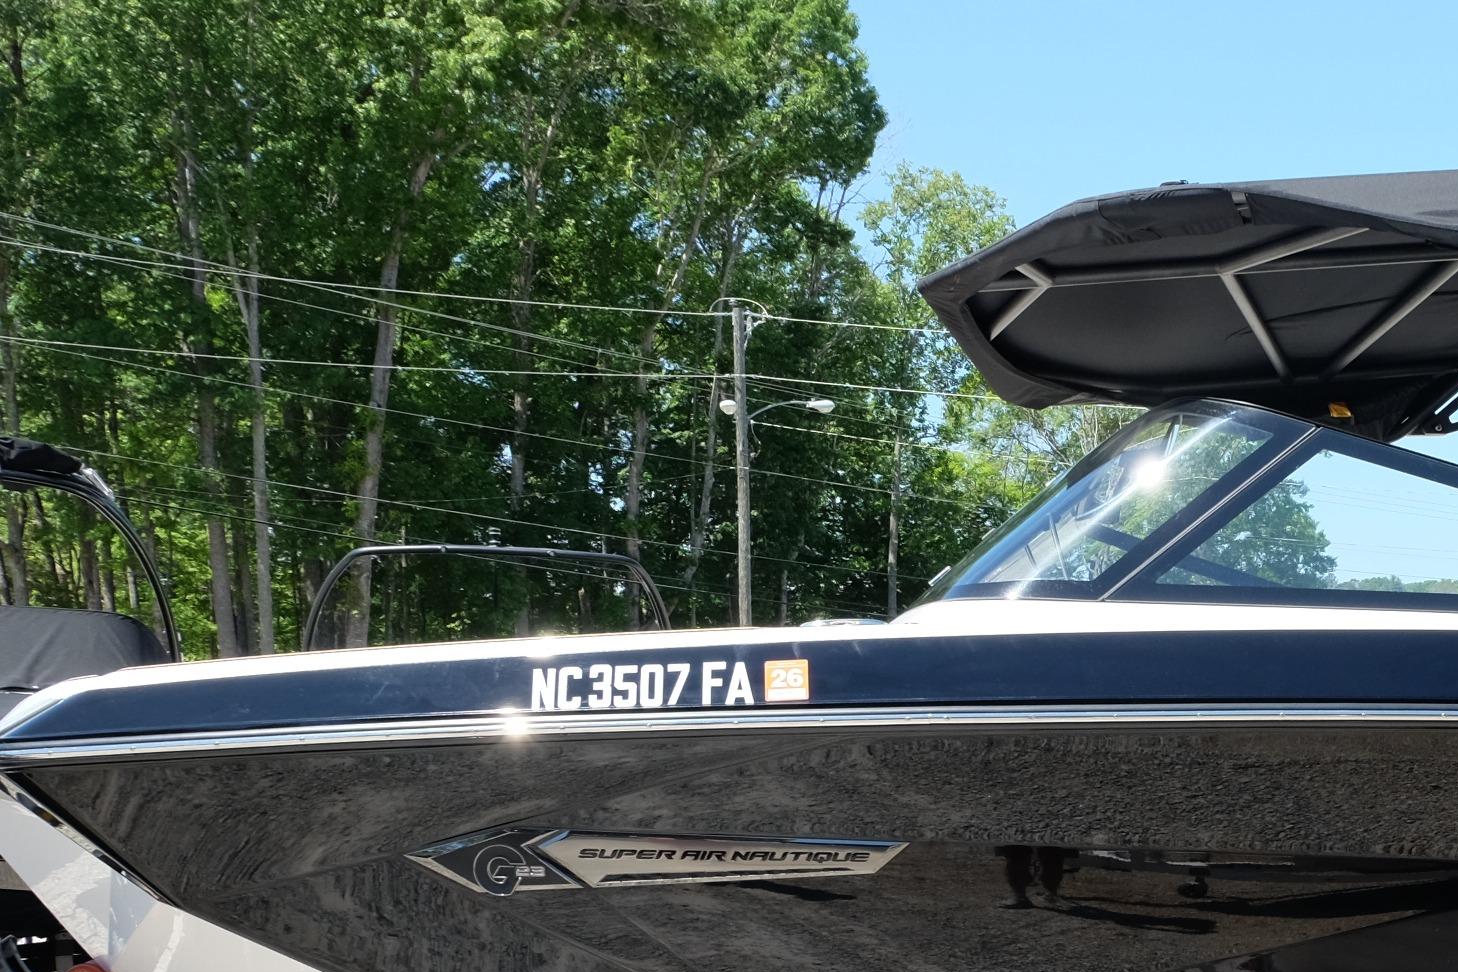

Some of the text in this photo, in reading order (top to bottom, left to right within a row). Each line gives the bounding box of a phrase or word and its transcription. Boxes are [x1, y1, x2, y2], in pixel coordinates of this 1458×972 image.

[701, 660, 755, 705] FA
[769, 666, 804, 688] 26
[577, 848, 871, 863] SUPER AIR NAUTIQUE
